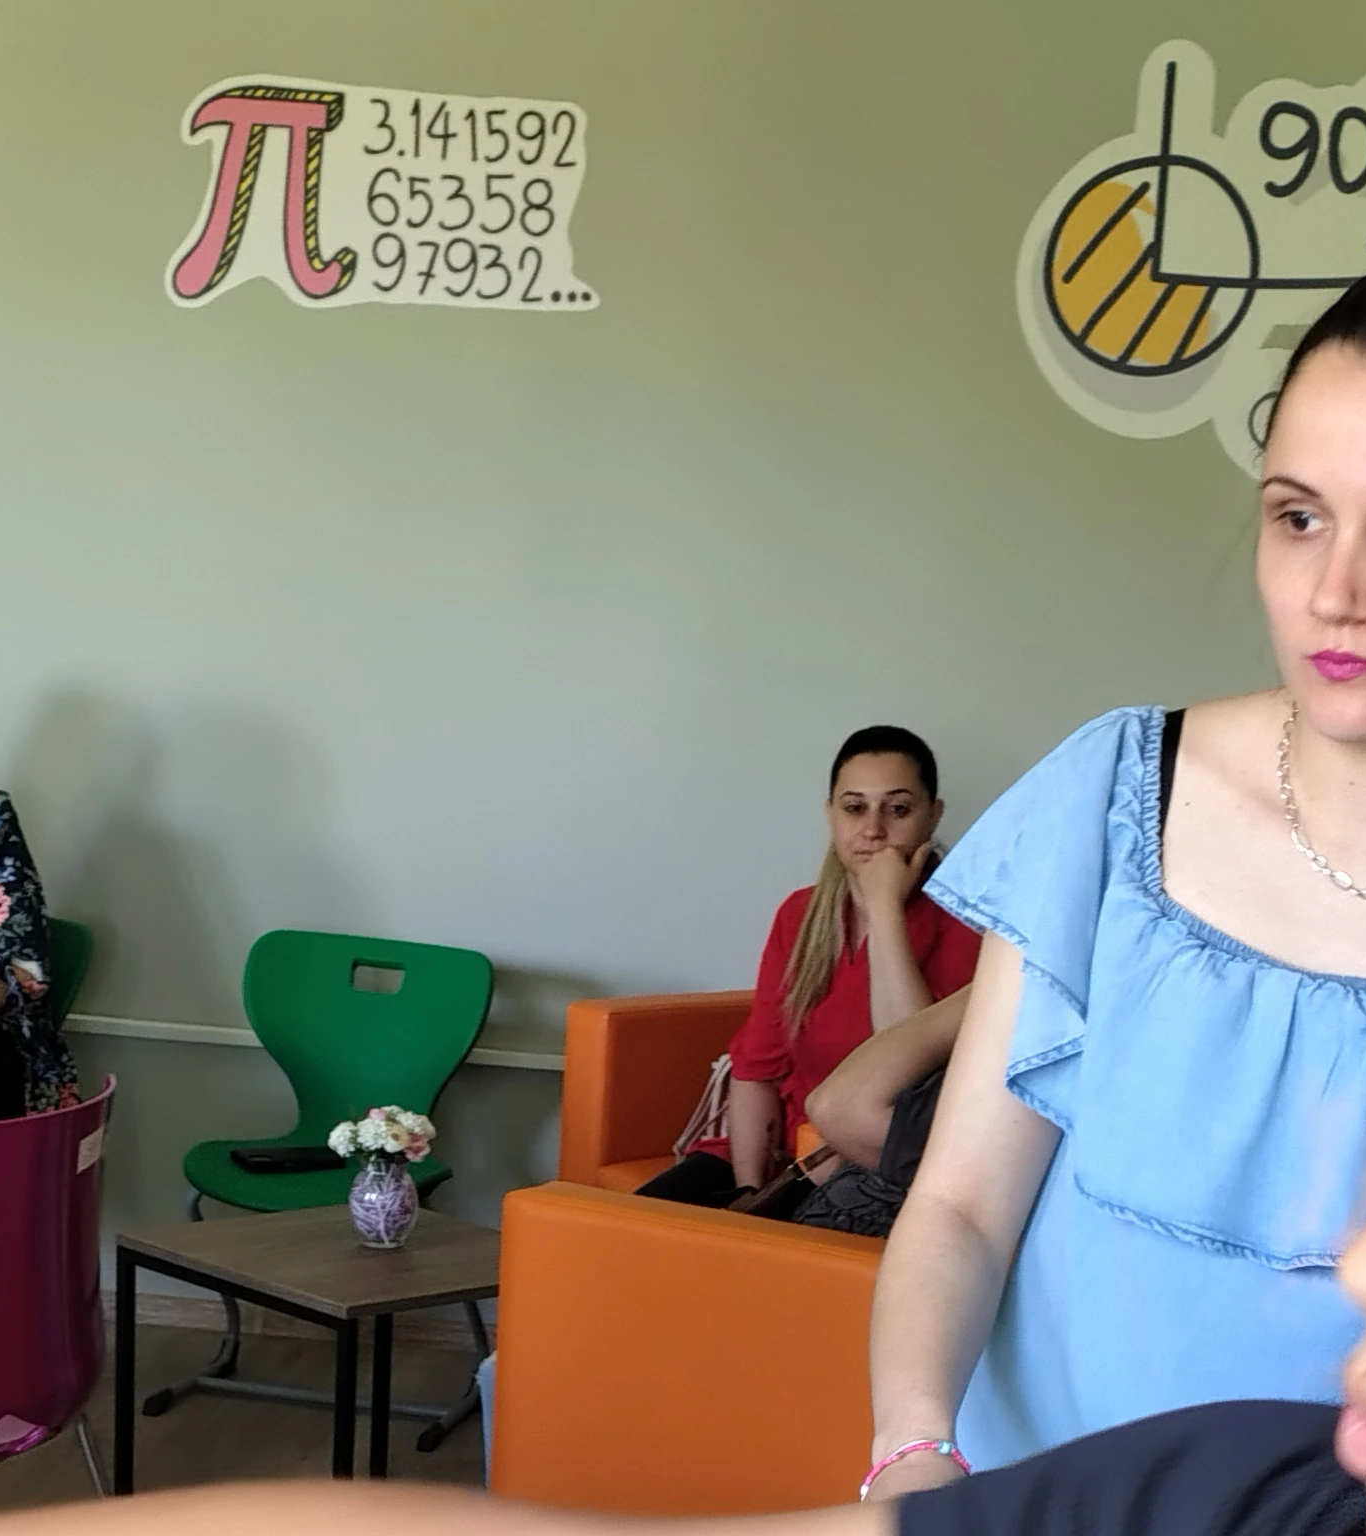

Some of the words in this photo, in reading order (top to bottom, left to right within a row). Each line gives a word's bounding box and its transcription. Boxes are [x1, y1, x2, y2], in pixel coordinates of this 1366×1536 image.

[363, 98, 577, 167] 3.141592
[367, 168, 555, 236] 65358
[371, 232, 592, 302] 97932...
